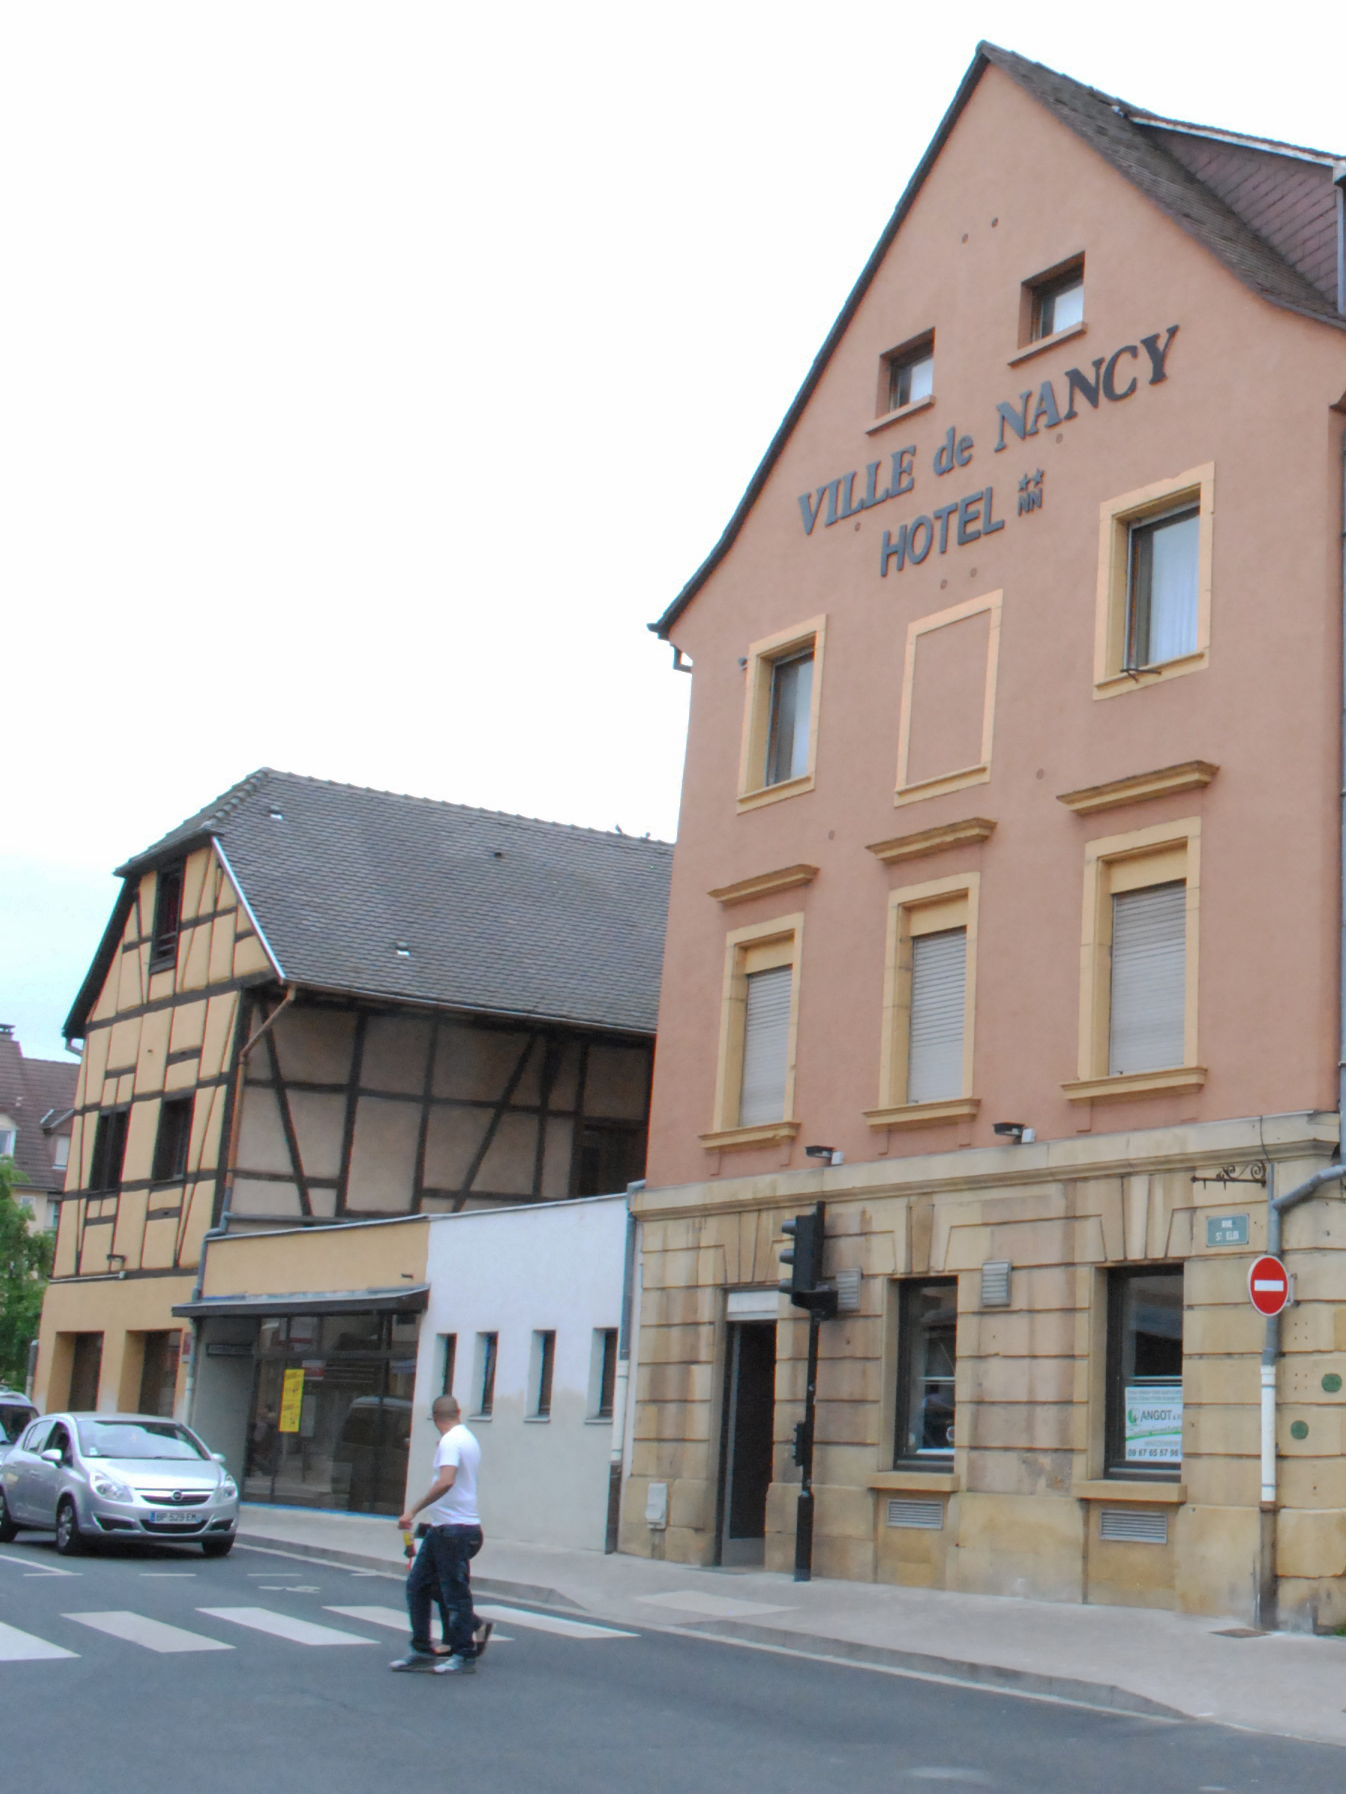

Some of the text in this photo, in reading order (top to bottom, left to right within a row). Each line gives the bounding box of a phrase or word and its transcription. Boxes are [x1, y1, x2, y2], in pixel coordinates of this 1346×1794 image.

[798, 325, 1179, 535] VILLE de NANCY
[880, 486, 1005, 577] HOTEL
[1221, 1220, 1233, 1228] RUE
[1141, 1410, 1172, 1422] ANGOT
